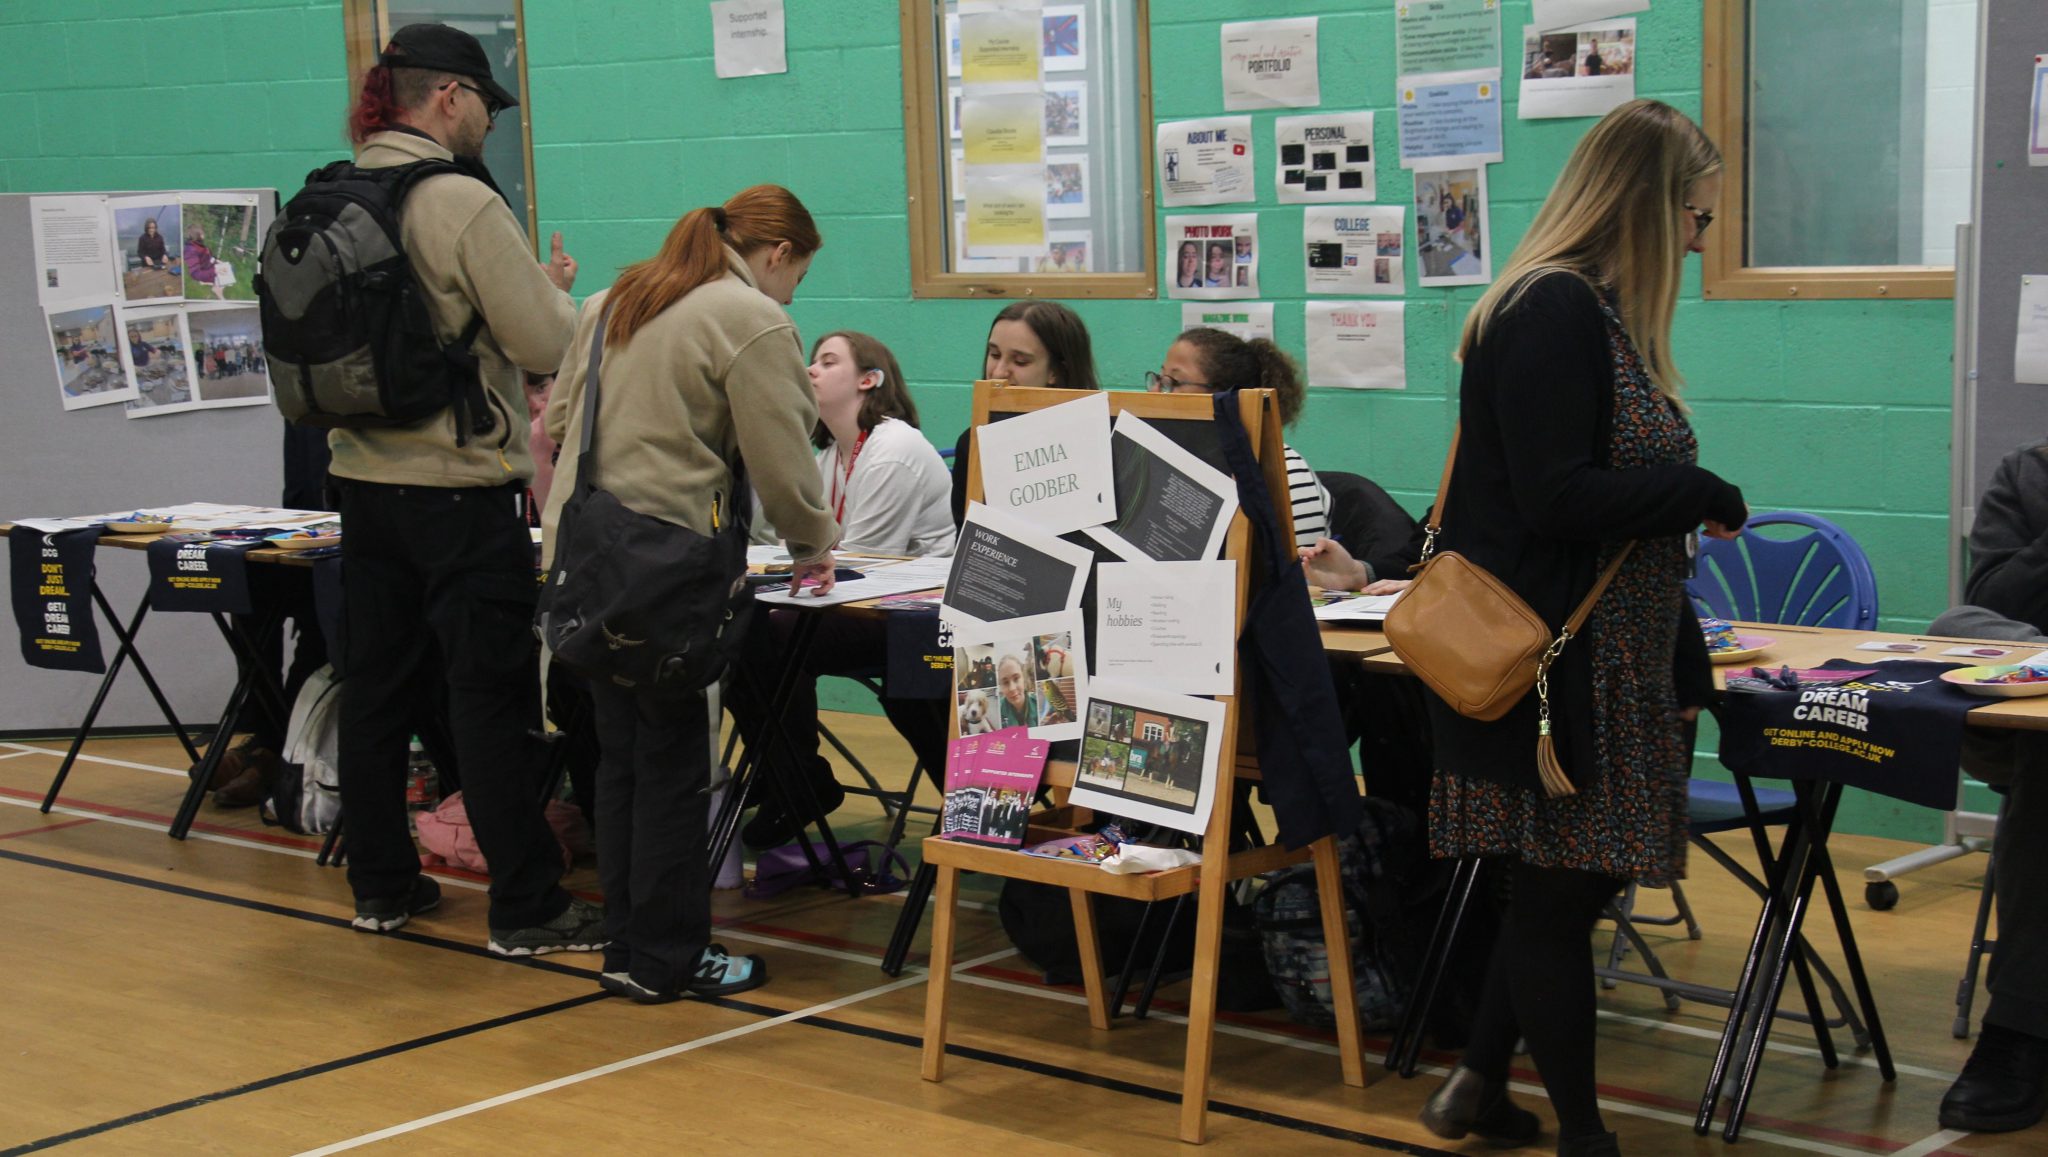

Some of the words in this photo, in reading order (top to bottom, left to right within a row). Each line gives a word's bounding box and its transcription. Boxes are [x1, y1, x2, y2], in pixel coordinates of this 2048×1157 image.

[1248, 58, 1291, 74] PORTFOLIO
[1187, 130, 1213, 145] ABOUT
[1215, 128, 1228, 142] ME
[1304, 126, 1347, 141] PERSONAL
[1184, 225, 1210, 238] PHOTO
[1211, 225, 1233, 238] WORK
[1334, 217, 1371, 232] COLLEGE
[1330, 312, 1359, 328] THANK
[1361, 312, 1377, 328] YOU
[1014, 443, 1068, 472] EMMA
[1010, 473, 1080, 507] GODBER
[975, 528, 1000, 546] WORK
[42, 548, 58, 557] DCG
[177, 549, 207, 560] DREAM
[970, 541, 1019, 568] EXPERIENCE
[177, 561, 208, 571] CAREER
[46, 575, 63, 584] JUST
[1106, 597, 1122, 612] My
[1106, 614, 1143, 627] hobbies
[1800, 691, 1870, 713] DREAM
[1793, 705, 1869, 732] CAREER
[1763, 728, 1779, 736] GET
[1780, 728, 1816, 739] ONLINE
[1817, 731, 1840, 741] AND
[1840, 736, 1870, 750] APPLY
[1869, 744, 1895, 758] NOW
[1771, 737, 1882, 763] DERBY-COLLEGE.AC.UK
